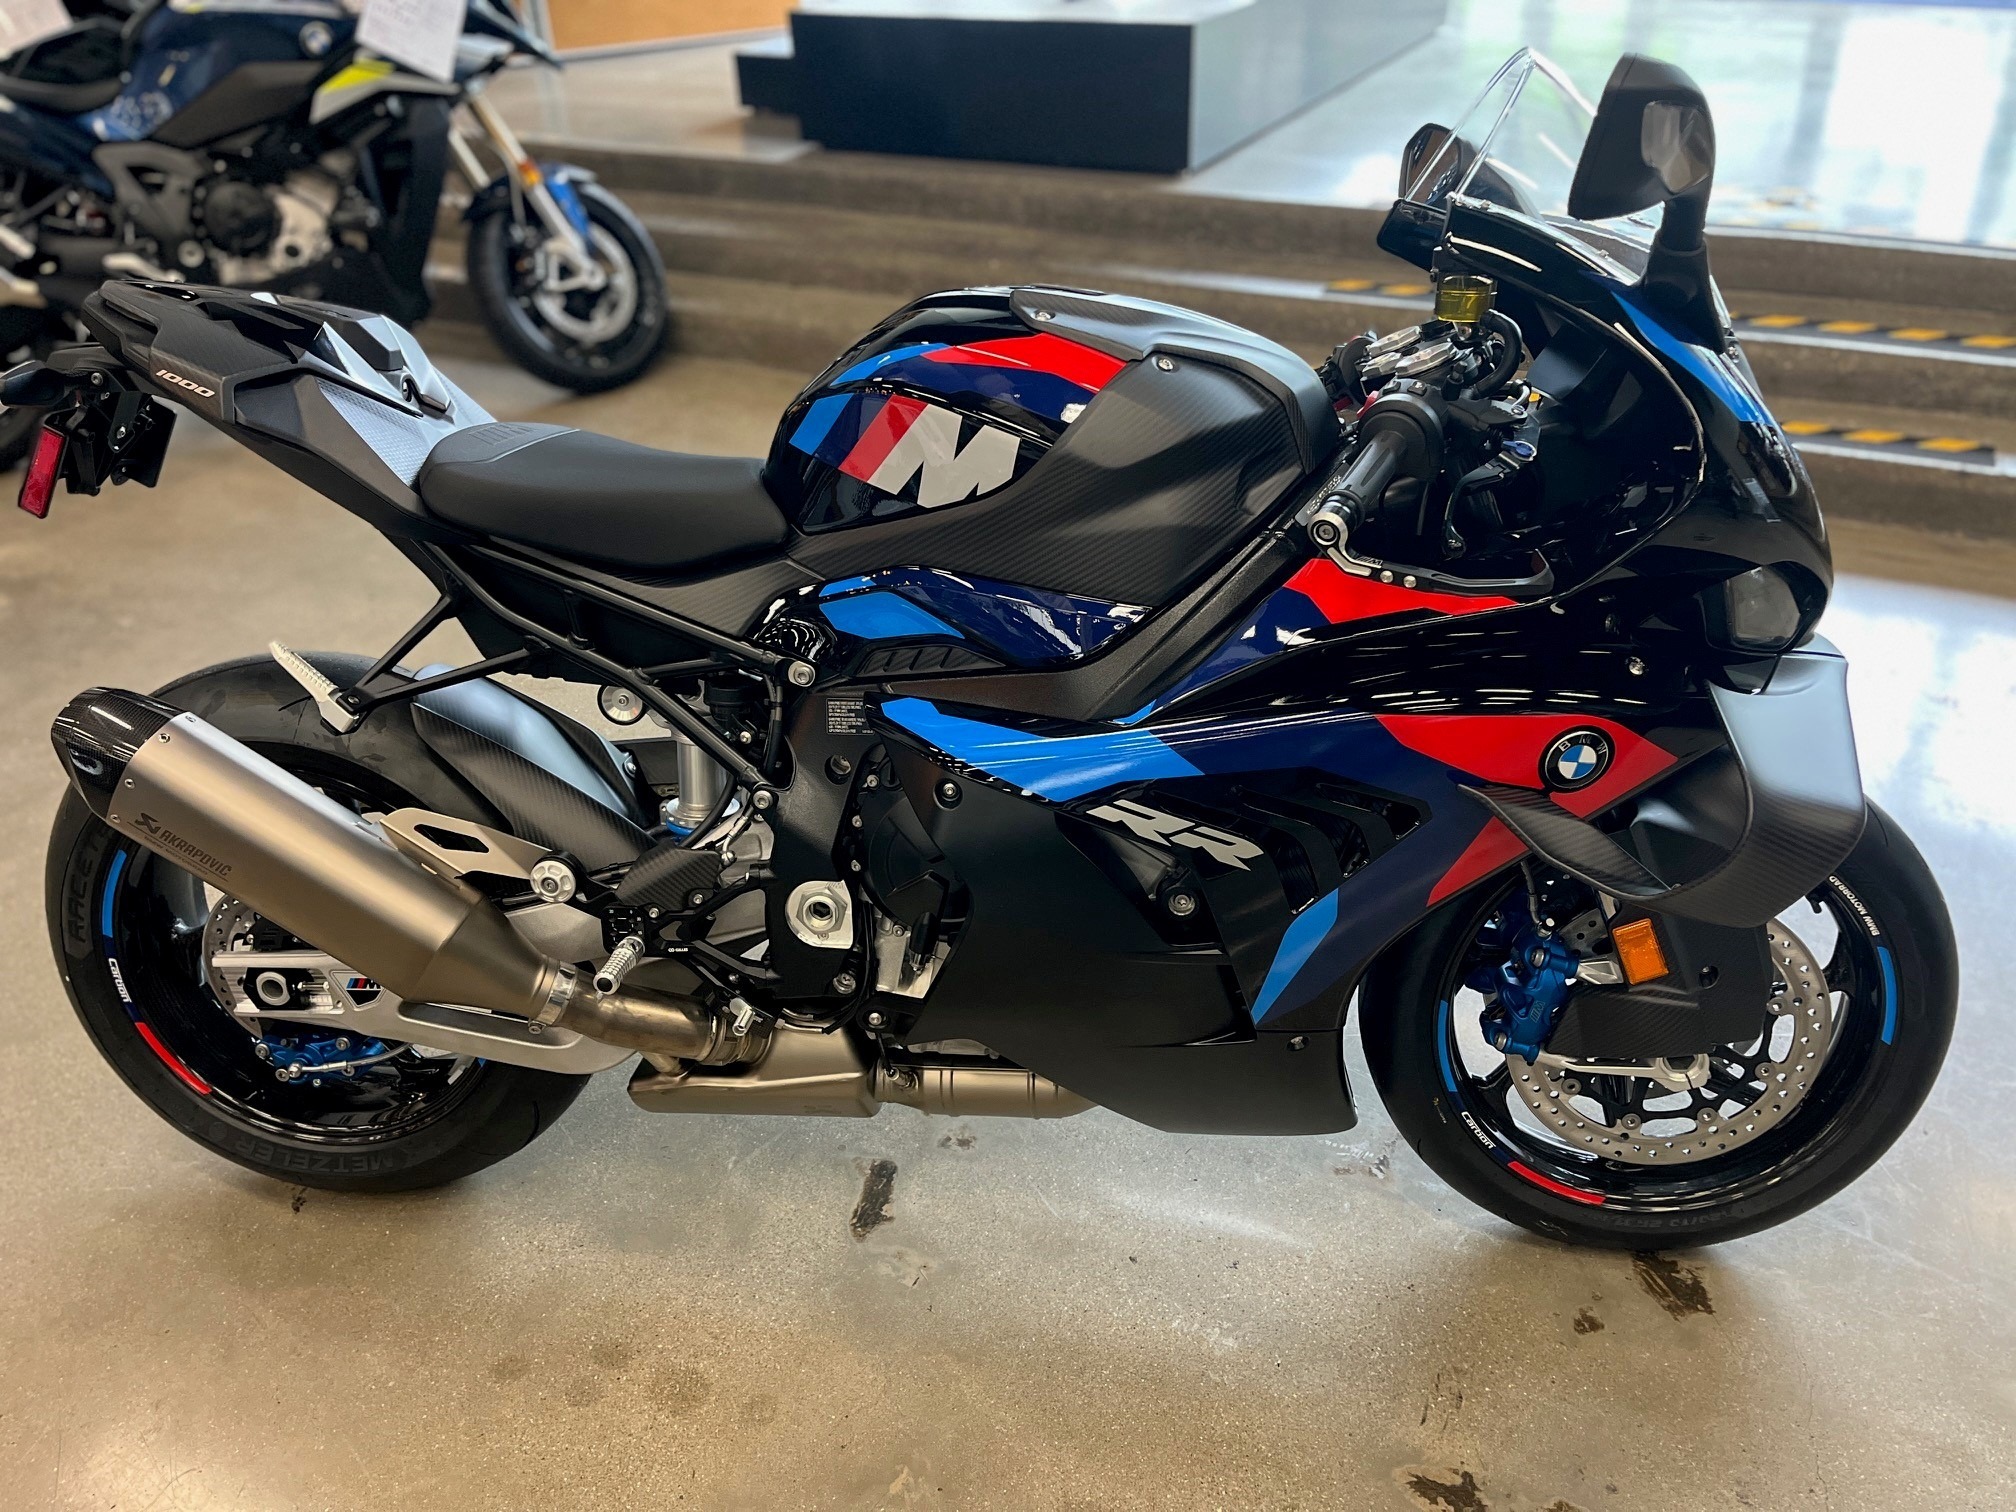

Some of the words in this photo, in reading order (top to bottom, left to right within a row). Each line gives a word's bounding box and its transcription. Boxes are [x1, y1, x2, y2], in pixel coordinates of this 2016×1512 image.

[156, 369, 215, 398] 1000
[868, 403, 1022, 509] M
[1558, 734, 1607, 755] BMW
[1086, 799, 1265, 871] RR
[1828, 875, 1868, 915] MOTORRAD
[1862, 915, 1880, 936] BMW
[234, 1136, 394, 1173] METZELER
